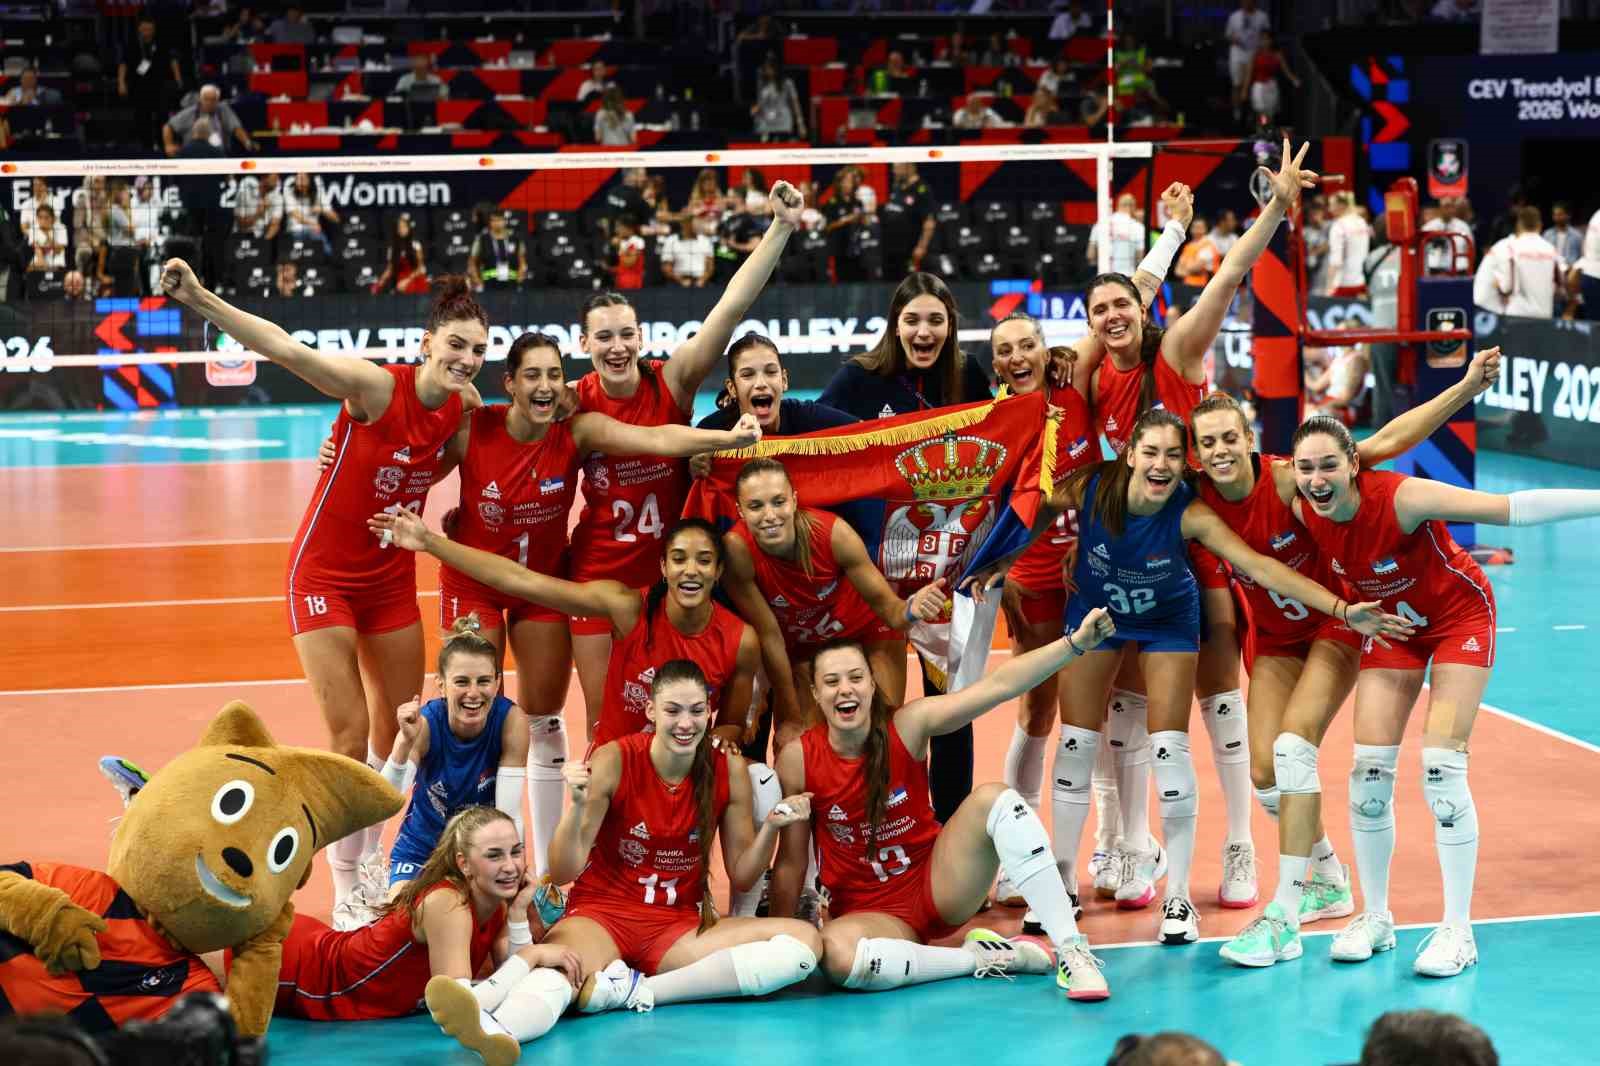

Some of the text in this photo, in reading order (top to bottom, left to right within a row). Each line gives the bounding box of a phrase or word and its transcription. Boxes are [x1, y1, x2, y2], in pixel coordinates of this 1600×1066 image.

[1468, 79, 1507, 99] CEV
[1509, 76, 1592, 101] Trendyol
[1518, 100, 1565, 120] 2026
[314, 174, 451, 206] Women
[0, 336, 54, 372] 26
[612, 492, 664, 542] 24
[304, 595, 328, 616] 18
[451, 597, 459, 618] 1
[1103, 582, 1157, 614] 32
[1267, 588, 1309, 620] 5
[396, 862, 414, 874] 16
[859, 844, 912, 882] 13
[638, 873, 680, 906] 11
